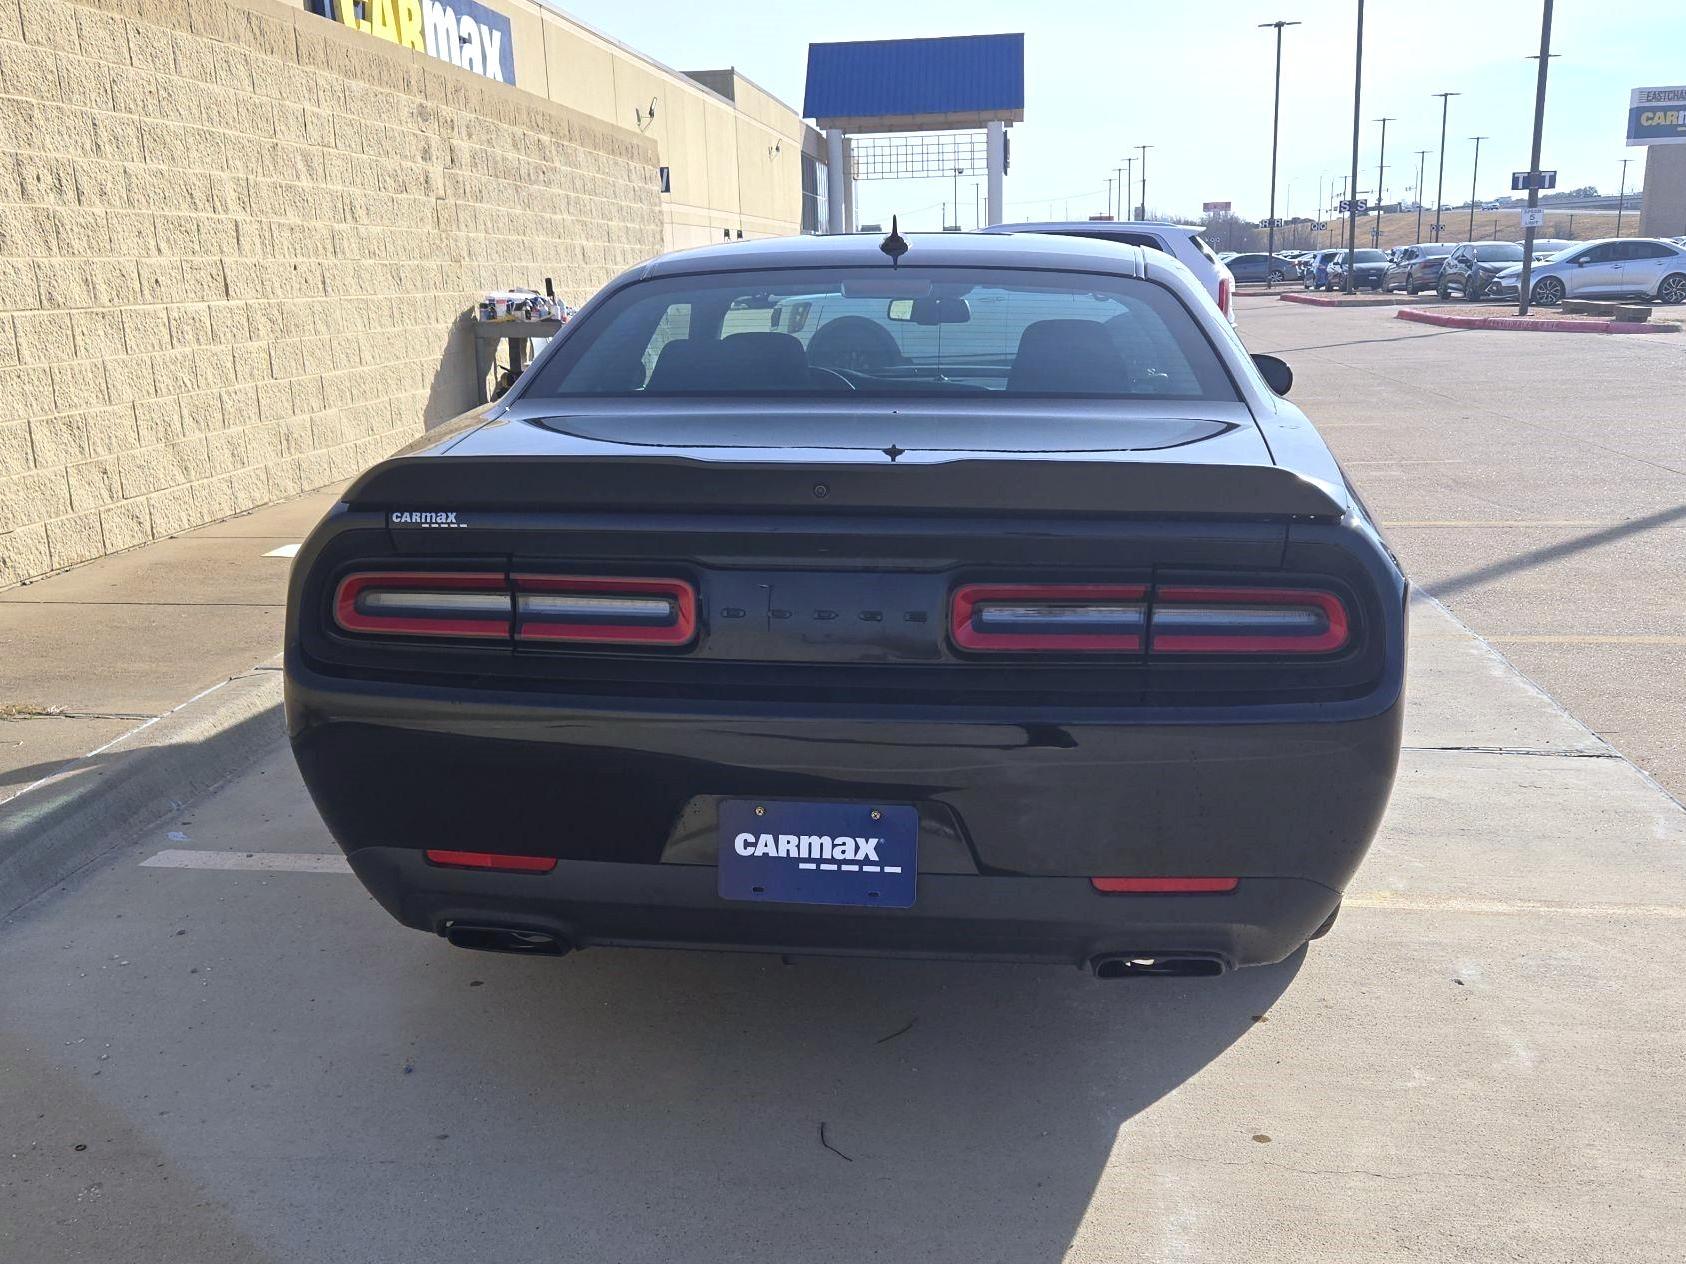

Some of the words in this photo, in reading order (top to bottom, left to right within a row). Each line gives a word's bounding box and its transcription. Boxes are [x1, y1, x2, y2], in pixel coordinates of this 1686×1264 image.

[1514, 173, 1528, 189] T
[1541, 172, 1555, 188] T
[1340, 201, 1350, 212] S
[1357, 200, 1367, 211] S
[392, 511, 457, 523] CARmax
[734, 832, 880, 862] CARmax
